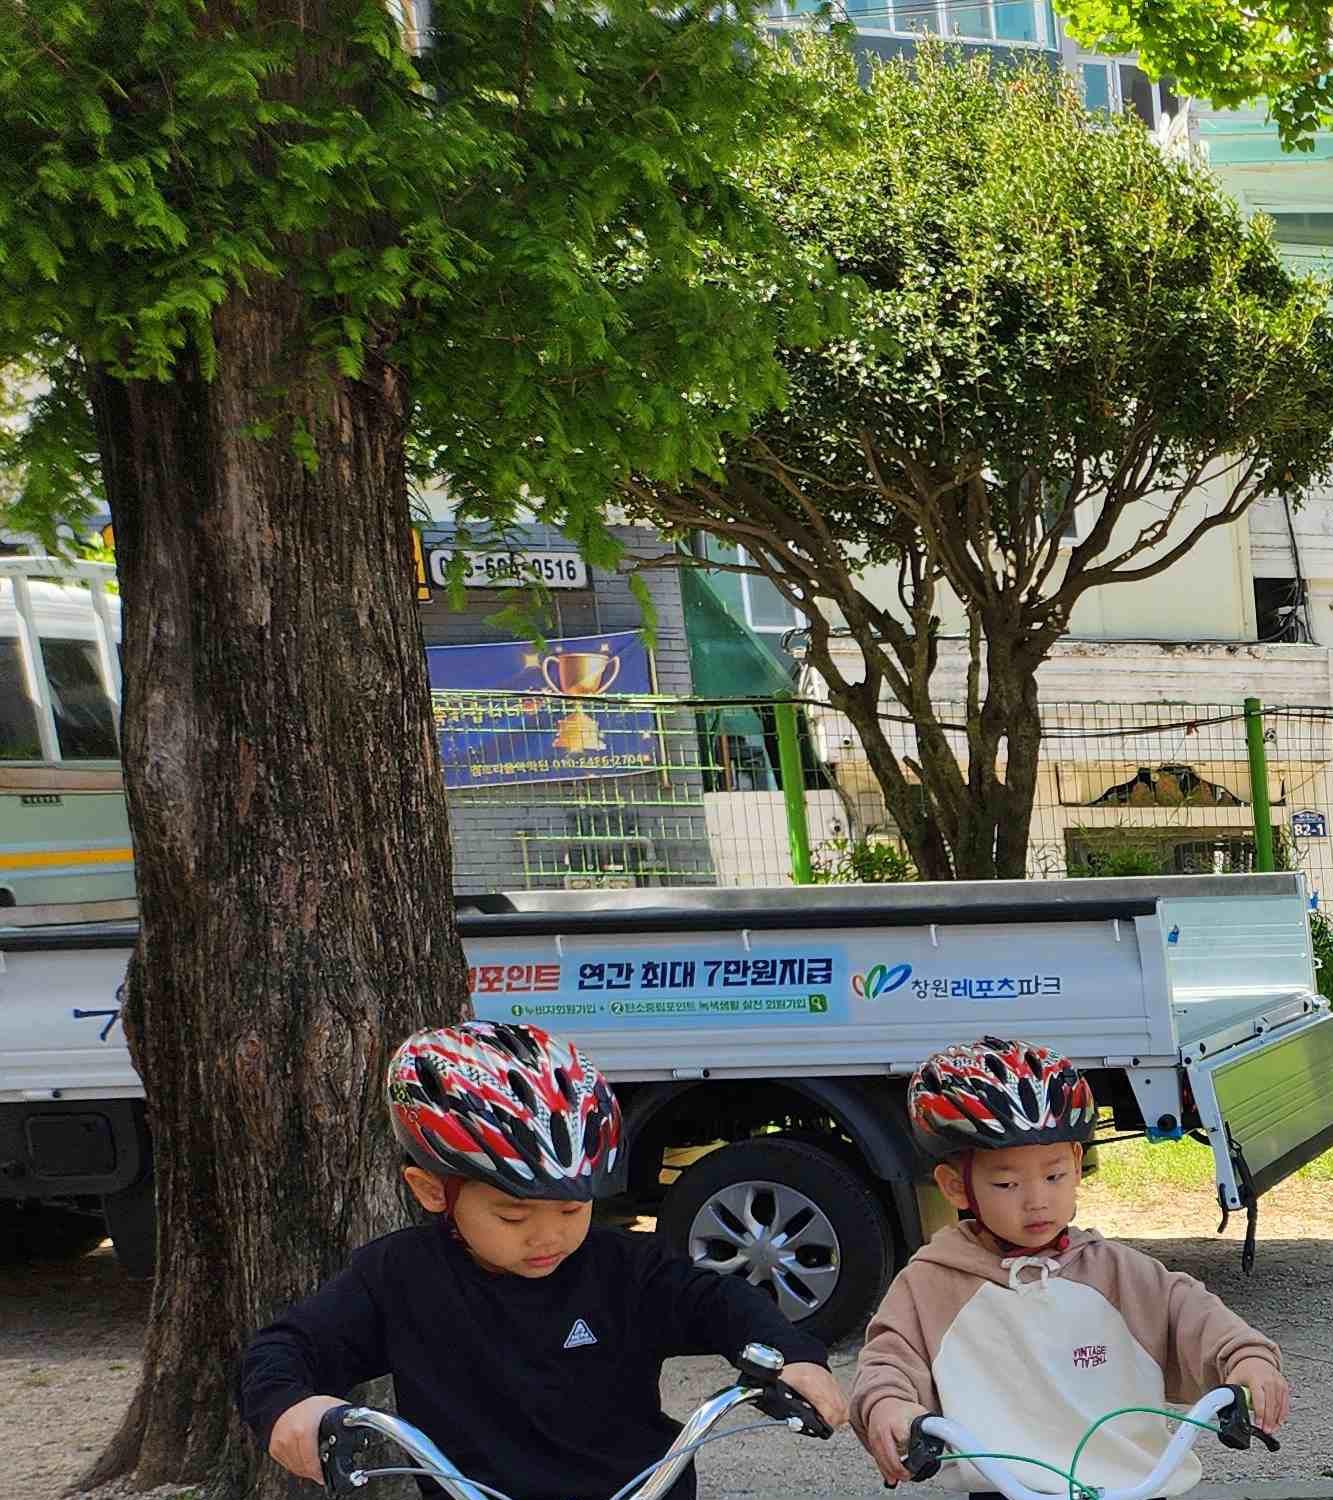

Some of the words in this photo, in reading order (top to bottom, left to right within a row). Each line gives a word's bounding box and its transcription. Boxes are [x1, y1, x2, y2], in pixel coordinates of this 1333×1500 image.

[1294, 823, 1324, 836] 82-1
[578, 962, 635, 990] 연간
[641, 960, 696, 988] 최대
[704, 958, 832, 987] 7만원지급
[911, 975, 1061, 999] 창원레포츠파크
